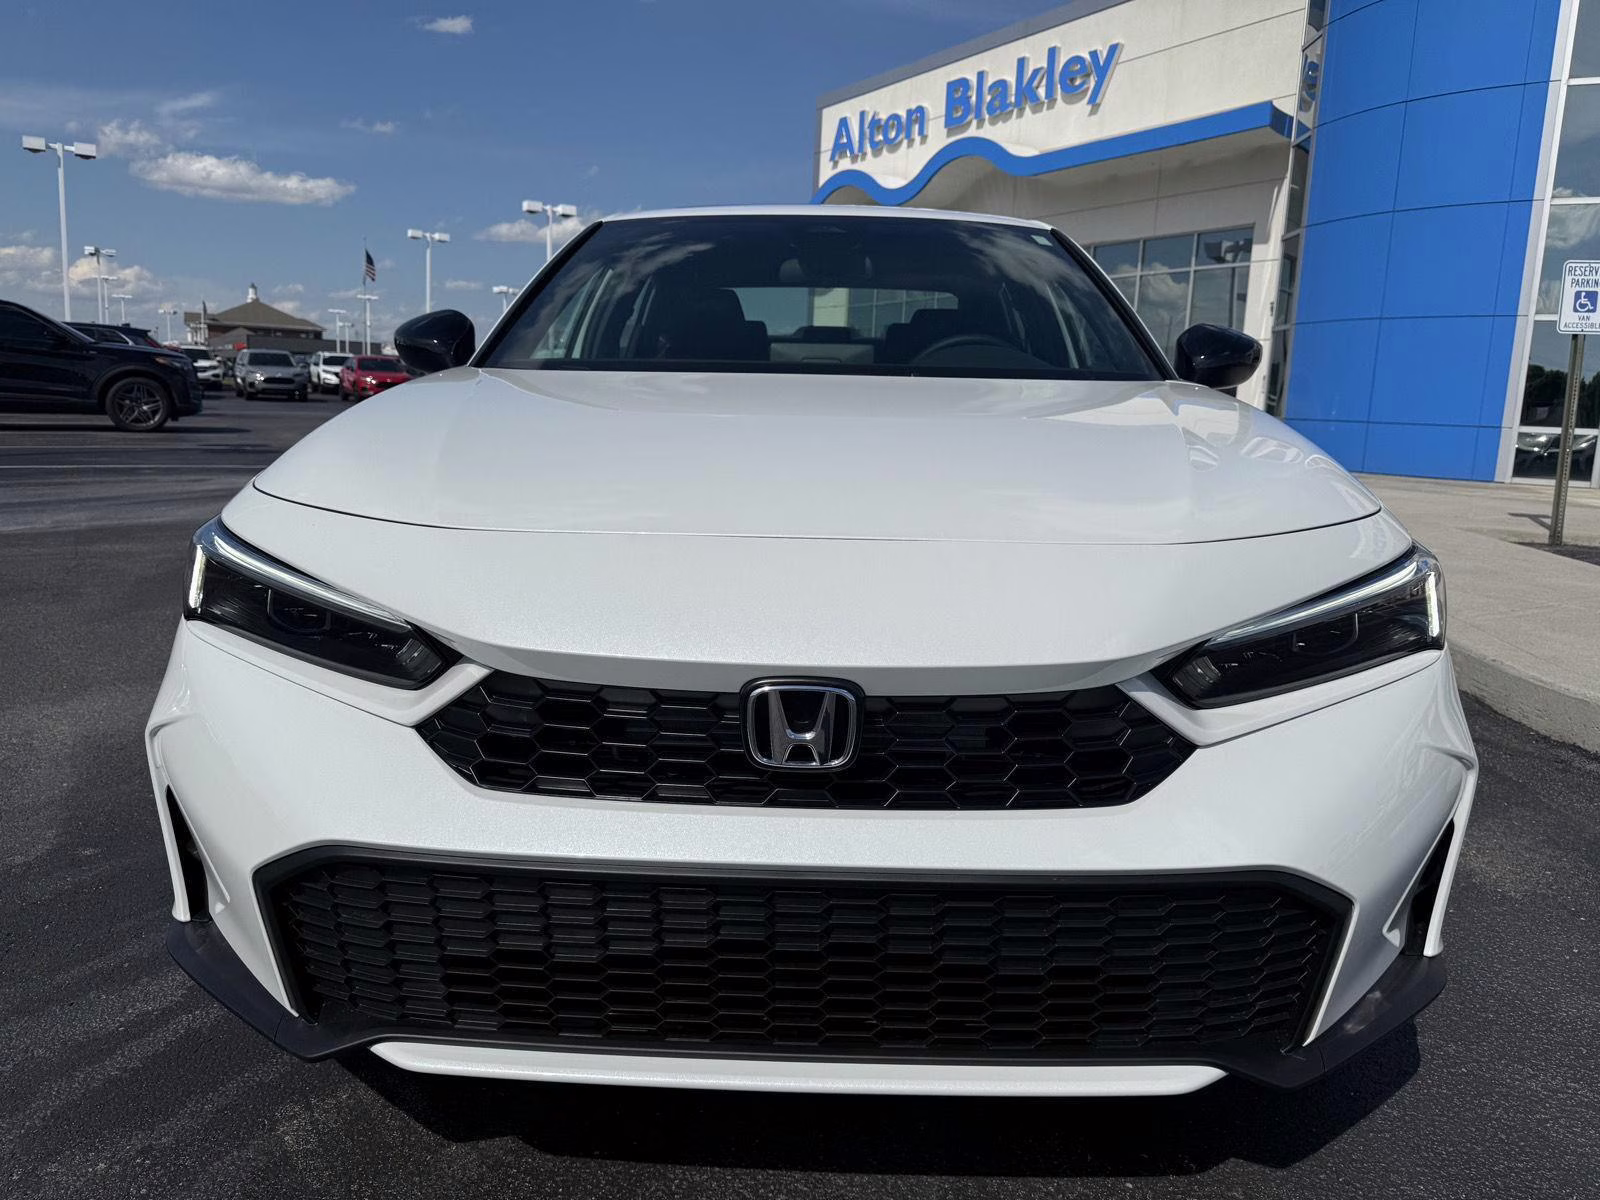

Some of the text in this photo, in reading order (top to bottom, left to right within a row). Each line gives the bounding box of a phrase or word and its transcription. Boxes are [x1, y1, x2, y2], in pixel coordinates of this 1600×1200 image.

[829, 42, 1124, 162] Alton Blakley
[1568, 265, 1600, 276] RESERV
[1570, 278, 1600, 288] PARKIN
